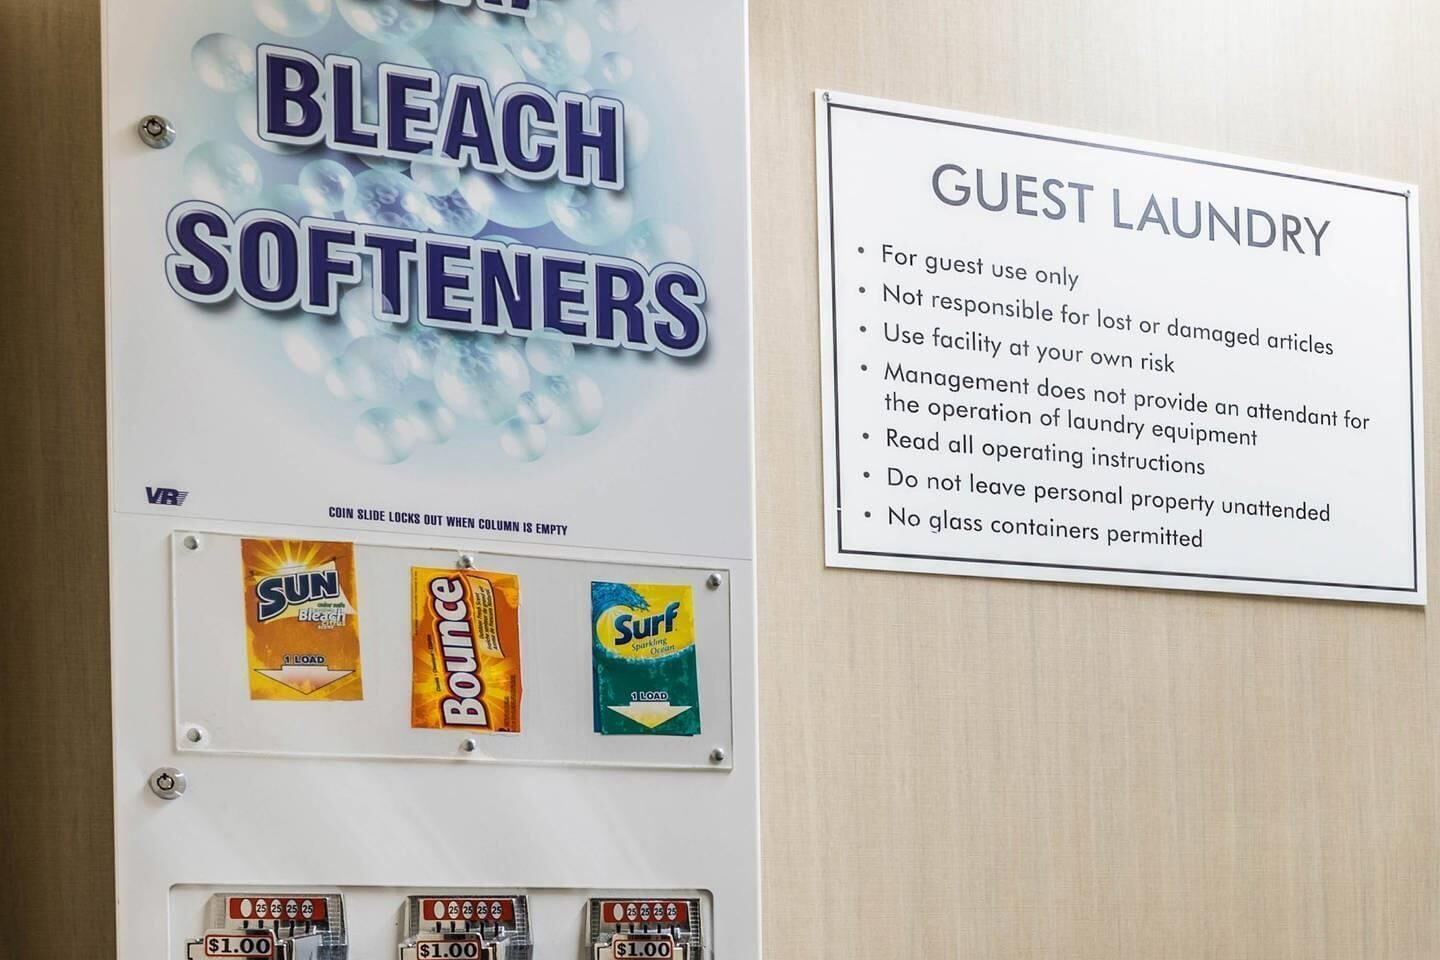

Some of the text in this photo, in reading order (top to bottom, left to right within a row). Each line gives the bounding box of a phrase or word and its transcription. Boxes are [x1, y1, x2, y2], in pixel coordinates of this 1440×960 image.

[263, 48, 622, 187] BLEACH
[931, 163, 1331, 257] GUEST LAUNDRY
[168, 203, 706, 355] SOFTENERS
[882, 243, 1079, 292] For guest use only
[882, 283, 1334, 356] Not responsible for lost or damaged articles
[883, 321, 1175, 374] Use facility at your own risk
[884, 361, 1370, 430] Management does not provide an attendant for
[884, 391, 1258, 447] the operation of laundry equipment
[886, 427, 1206, 476] Read all operating instructions
[887, 466, 1330, 522] Do not leave personal property unattended
[329, 506, 568, 536] COIN SLIDE LOCKS OUT WHEN COLUMN IS EMPTY
[888, 505, 1203, 548] No glass containers permitted
[257, 571, 339, 621] SUN
[299, 609, 346, 622] Bleach
[614, 602, 680, 645] Surf
[631, 637, 668, 652] Sparkling
[284, 655, 325, 665] 1 LOAD
[431, 577, 487, 726] Bounce
[650, 644, 675, 655] Ocean
[630, 691, 668, 701] 1 LOAD
[256, 904, 313, 914] 25 25 25 25
[449, 905, 502, 915] 25 25 25 25
[628, 907, 677, 916] 25 25 25 25
[208, 938, 270, 954] $1.00
[420, 943, 478, 958] $1.00
[617, 942, 670, 957] $1.00
